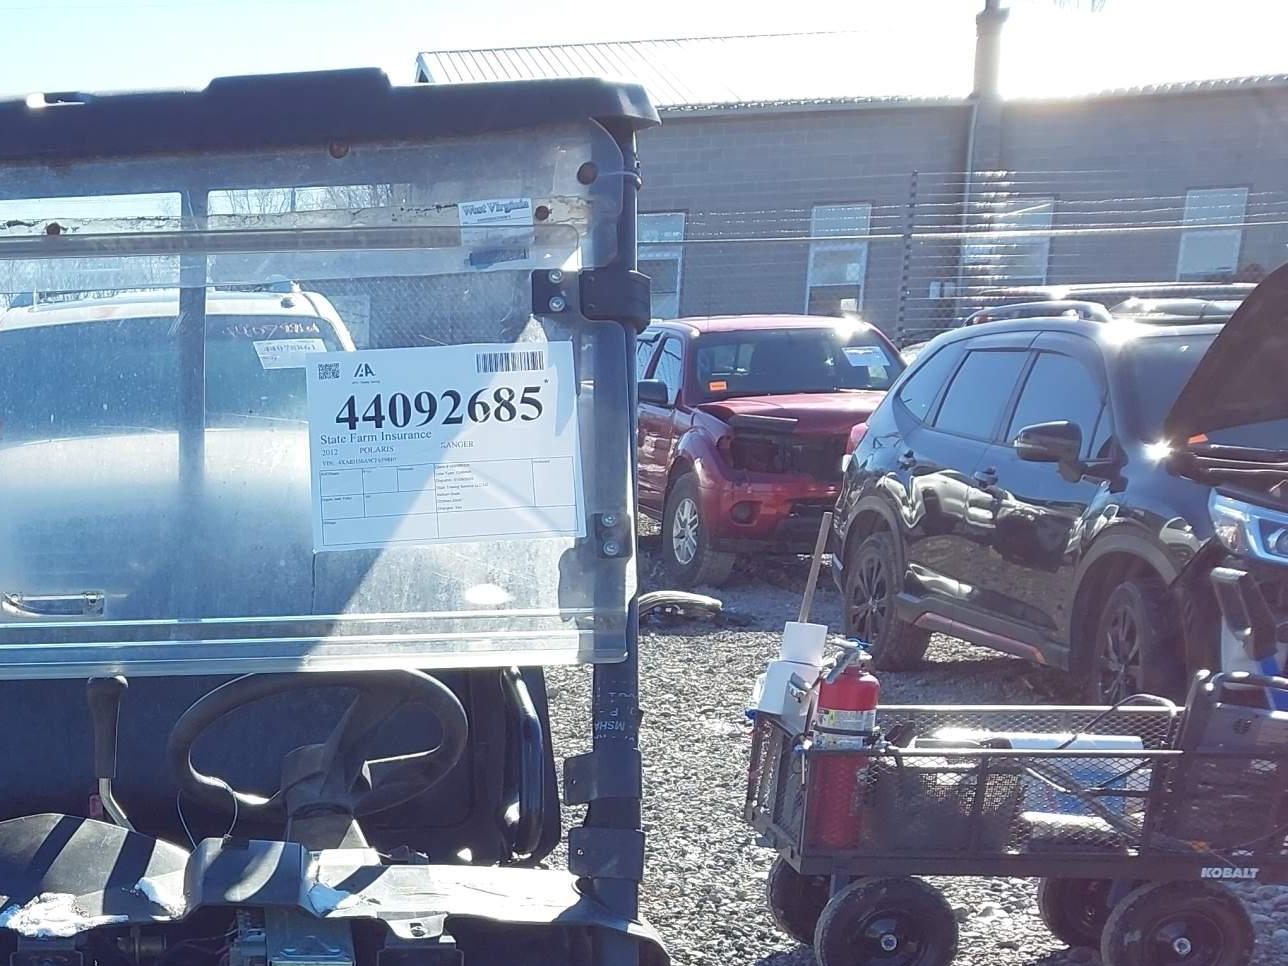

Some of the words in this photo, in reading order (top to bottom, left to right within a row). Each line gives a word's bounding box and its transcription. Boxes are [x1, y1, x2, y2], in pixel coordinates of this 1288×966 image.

[335, 386, 543, 430] 44092685
[320, 435, 346, 445] State
[350, 433, 377, 443] Farm
[381, 430, 432, 441] Insurance
[359, 446, 394, 454] POLARIS
[1201, 867, 1260, 878] KOBALT
